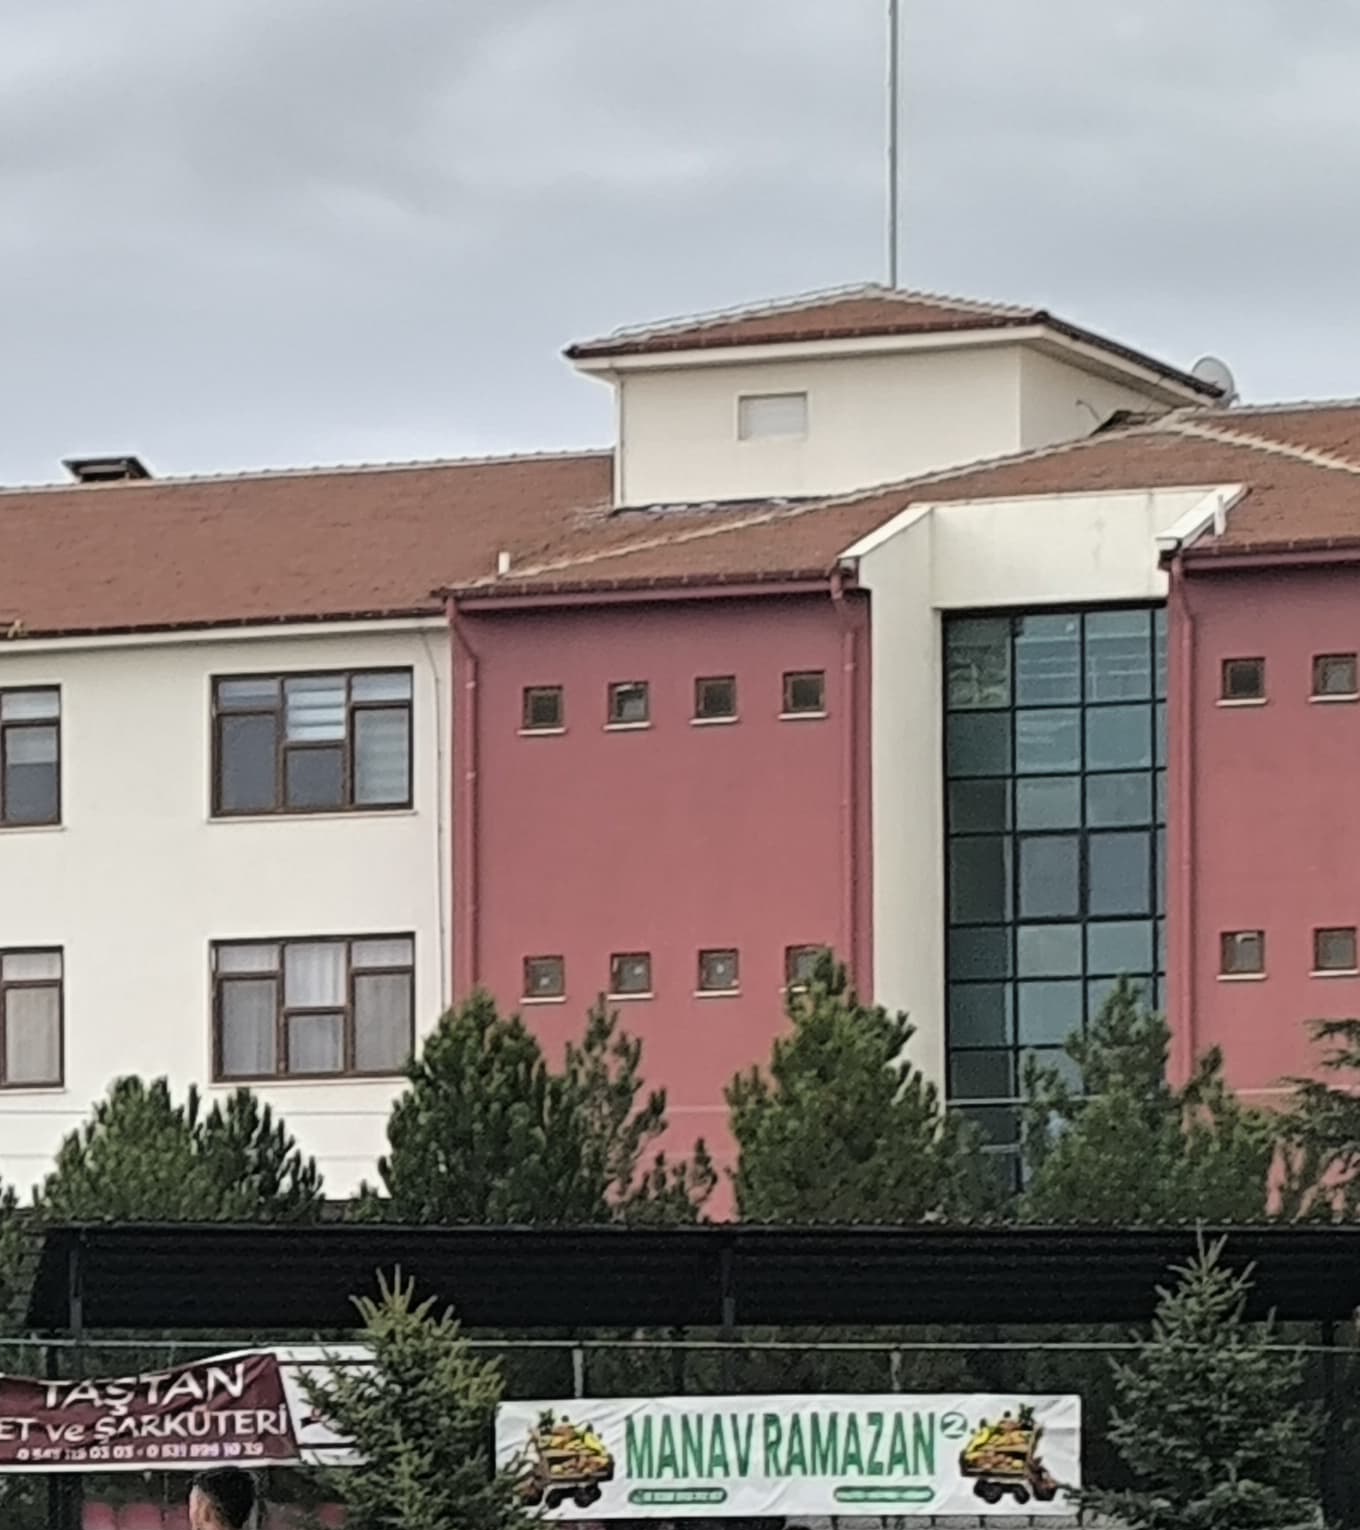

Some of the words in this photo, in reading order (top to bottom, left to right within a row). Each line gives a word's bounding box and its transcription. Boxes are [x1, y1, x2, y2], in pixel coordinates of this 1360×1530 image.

[44, 1364, 246, 1417] TAŞTAN
[95, 1405, 288, 1444] ŞARKÜTERİ
[625, 1413, 755, 1479] MANAV
[763, 1412, 936, 1477] RAMAZAN
